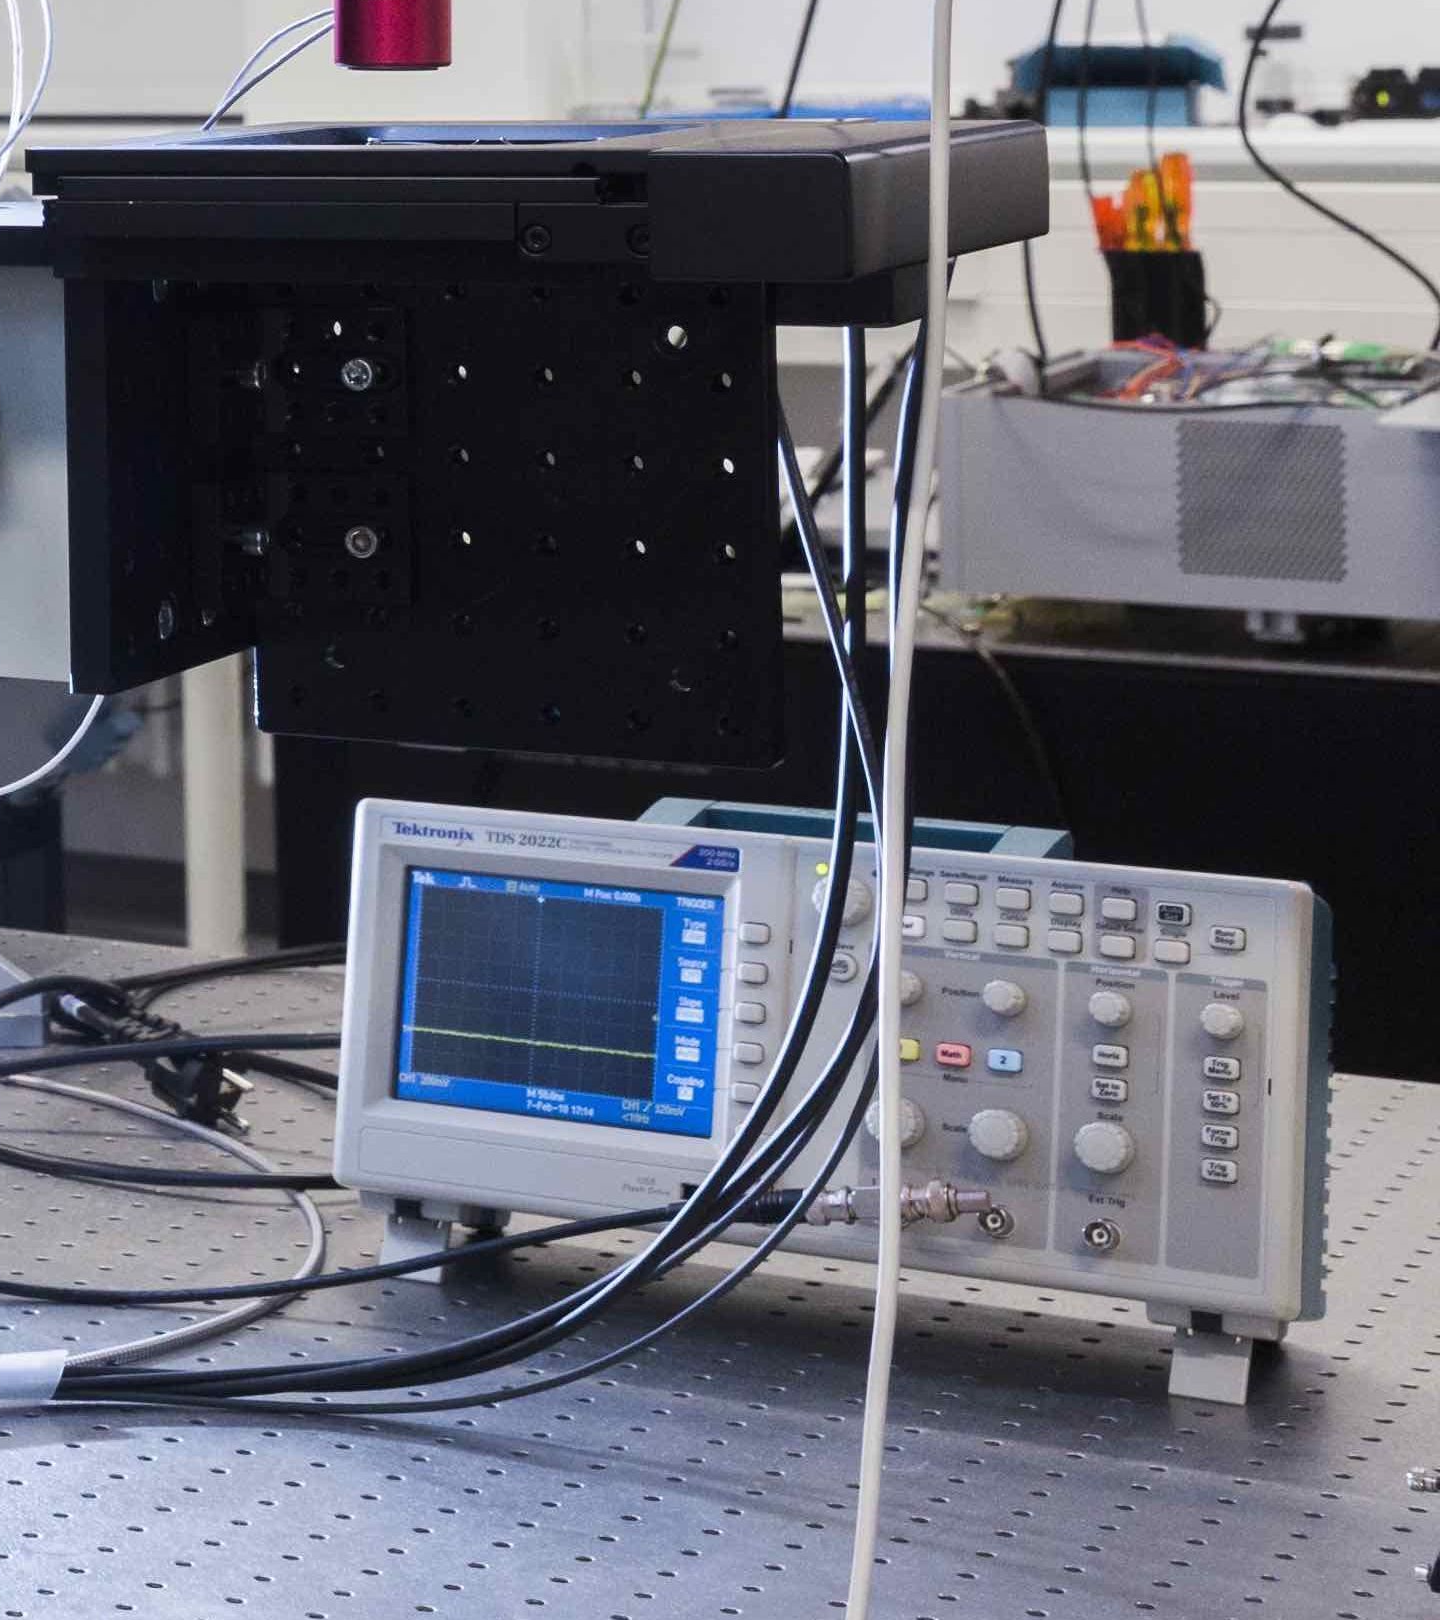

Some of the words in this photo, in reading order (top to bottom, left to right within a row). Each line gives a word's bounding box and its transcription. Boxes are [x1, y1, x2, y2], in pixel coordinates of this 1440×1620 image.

[392, 822, 474, 846] Tektronix
[485, 833, 516, 847] TDS
[519, 833, 566, 850] 2022C
[1213, 990, 1240, 1001] Level
[941, 1049, 962, 1060] Math
[1000, 1055, 1007, 1064] 2
